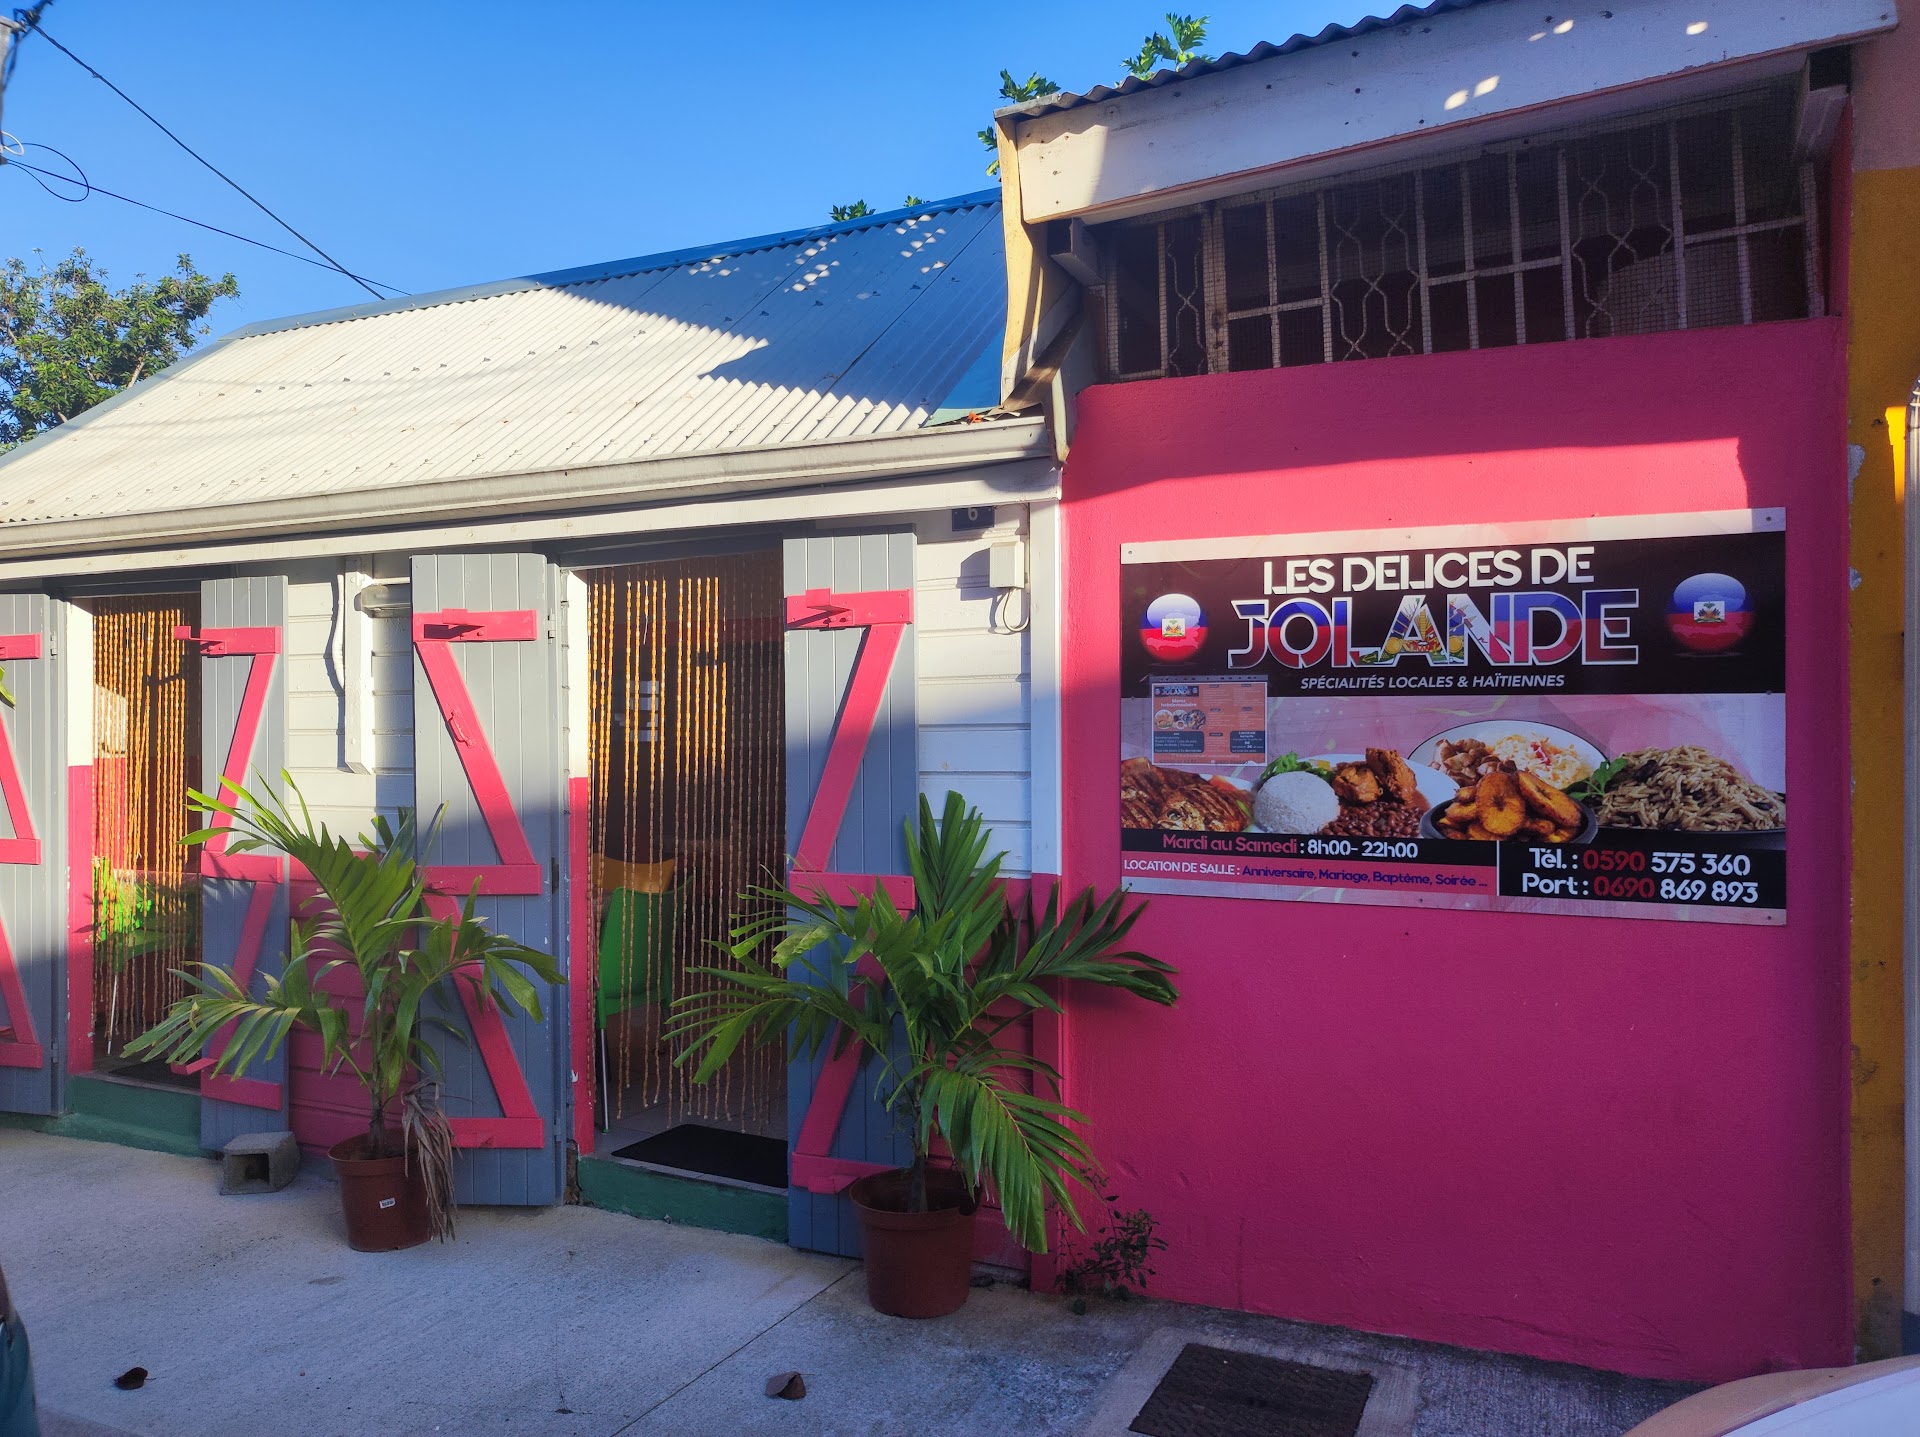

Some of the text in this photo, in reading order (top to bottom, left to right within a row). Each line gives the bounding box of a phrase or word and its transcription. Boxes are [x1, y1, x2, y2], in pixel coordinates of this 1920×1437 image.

[968, 507, 978, 521] 6
[1263, 545, 1595, 595] LES DELICES DE
[1227, 588, 1640, 669] JOLANDE
[1300, 672, 1565, 690] SPÉCIALITÉS LOCALES & HAÏTIENNES
[1162, 834, 1208, 850] Mardi
[1210, 839, 1233, 851] au
[1235, 838, 1298, 854] Samedi
[1361, 841, 1419, 858] 22h00
[1123, 859, 1181, 873] LOCATION
[1181, 861, 1198, 873] DE
[1199, 863, 1235, 875] SALLE
[1241, 865, 1317, 881] Anniversaire,
[1318, 869, 1371, 884] Mariage,
[1435, 873, 1477, 887] Soirée
[1528, 847, 1567, 869] Tél.
[1583, 849, 1646, 871] 0590
[1651, 851, 1696, 874] 575
[1701, 853, 1751, 877] 360
[1522, 873, 1579, 896] Port
[1593, 875, 1656, 899] 0690
[1660, 878, 1706, 901] 869
[1711, 880, 1759, 904] 893
